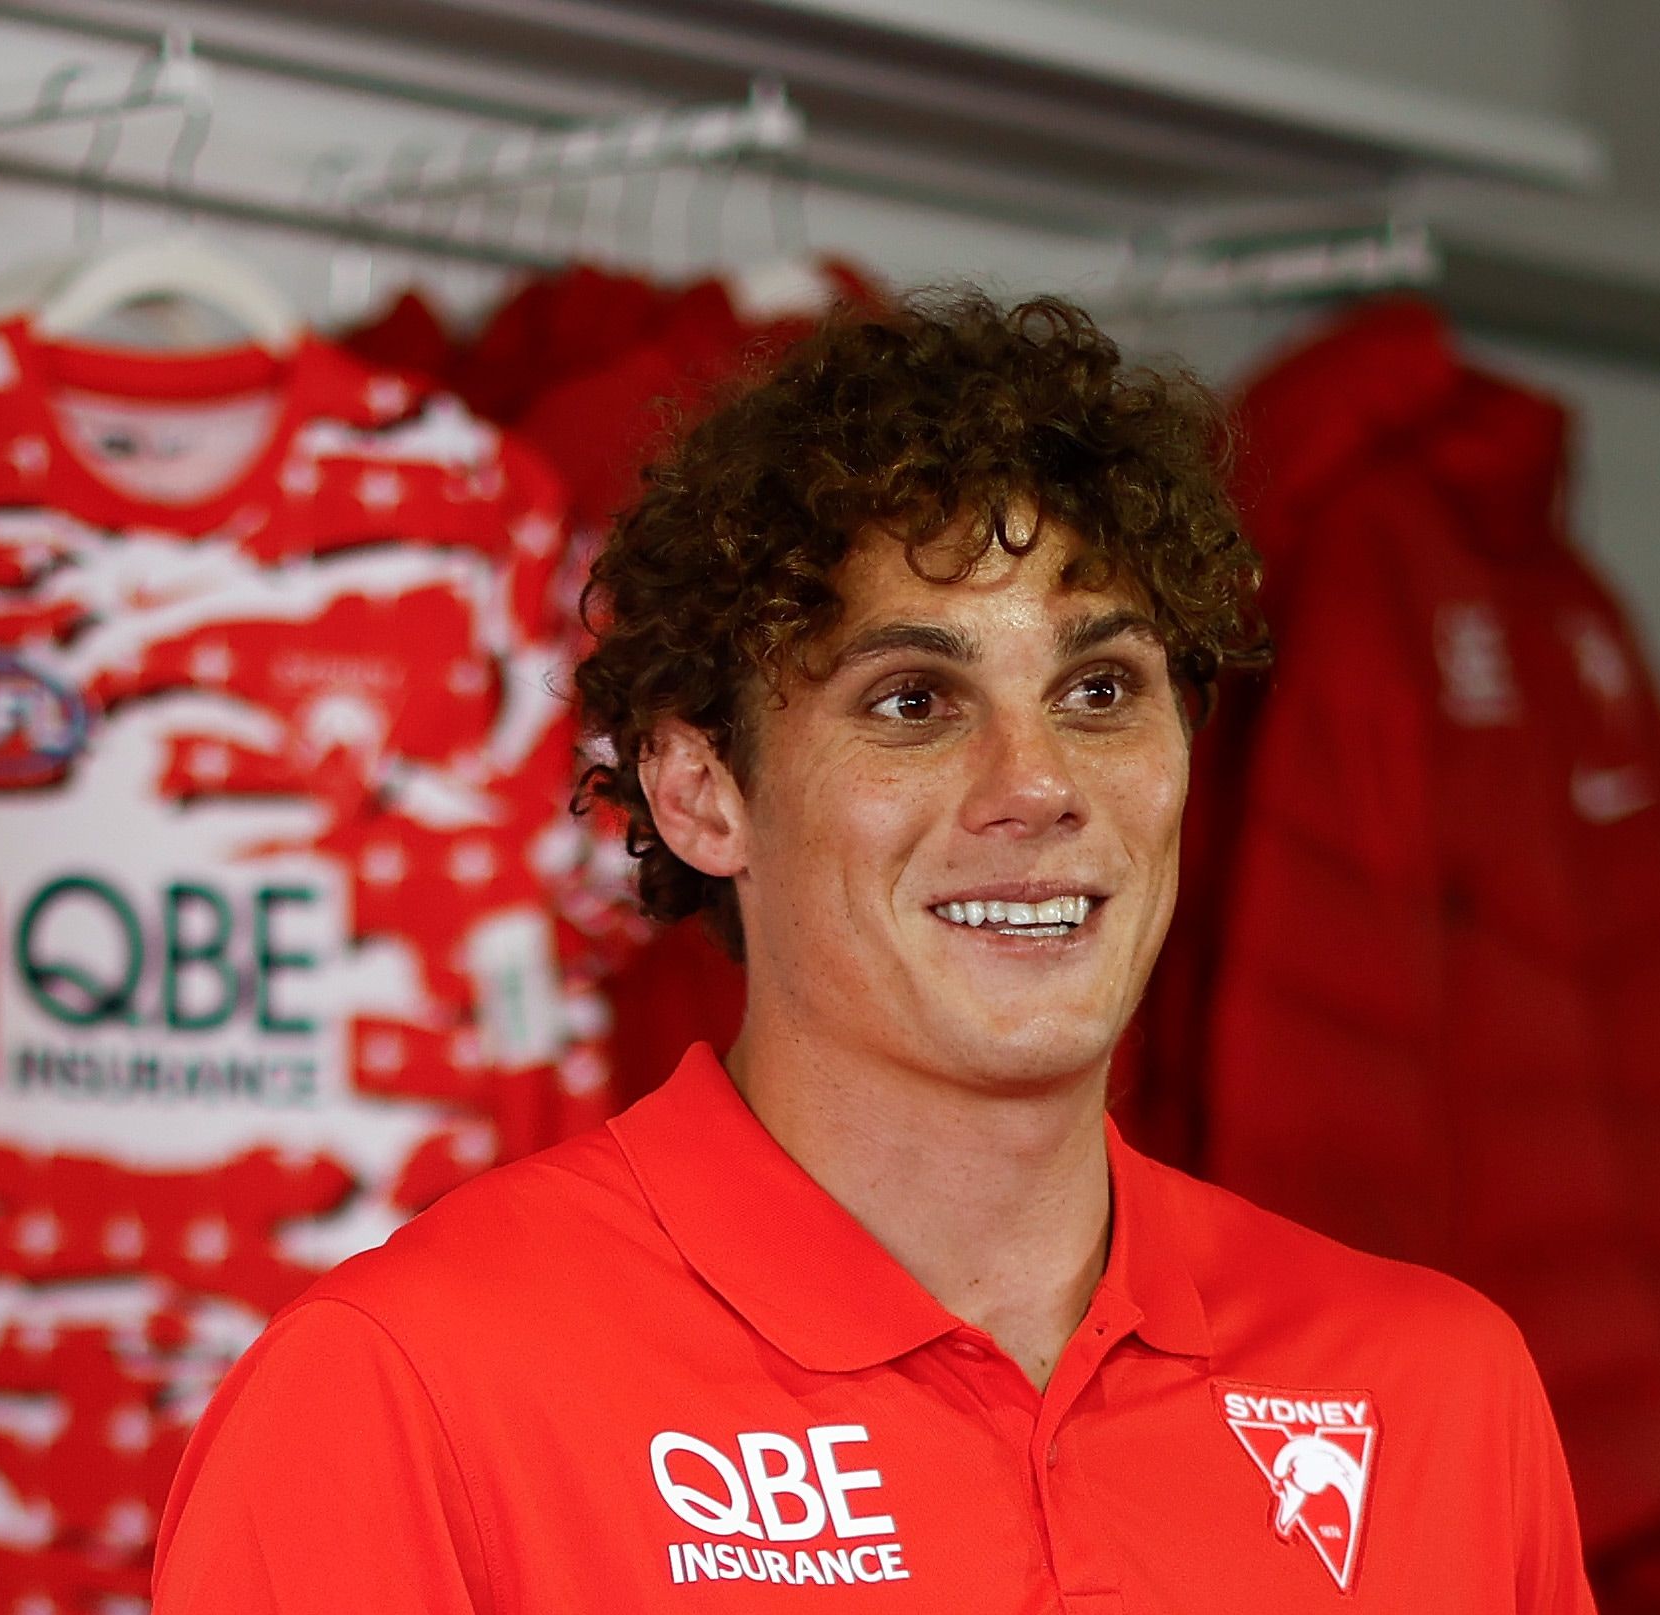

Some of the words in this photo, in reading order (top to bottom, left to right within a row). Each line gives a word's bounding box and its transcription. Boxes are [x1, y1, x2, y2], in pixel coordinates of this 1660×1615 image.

[17, 874, 317, 1034] QBE
[1224, 1392, 1366, 1425] SYDNEY
[649, 1424, 897, 1542] QBE
[667, 1541, 911, 1585] INSURANCE
